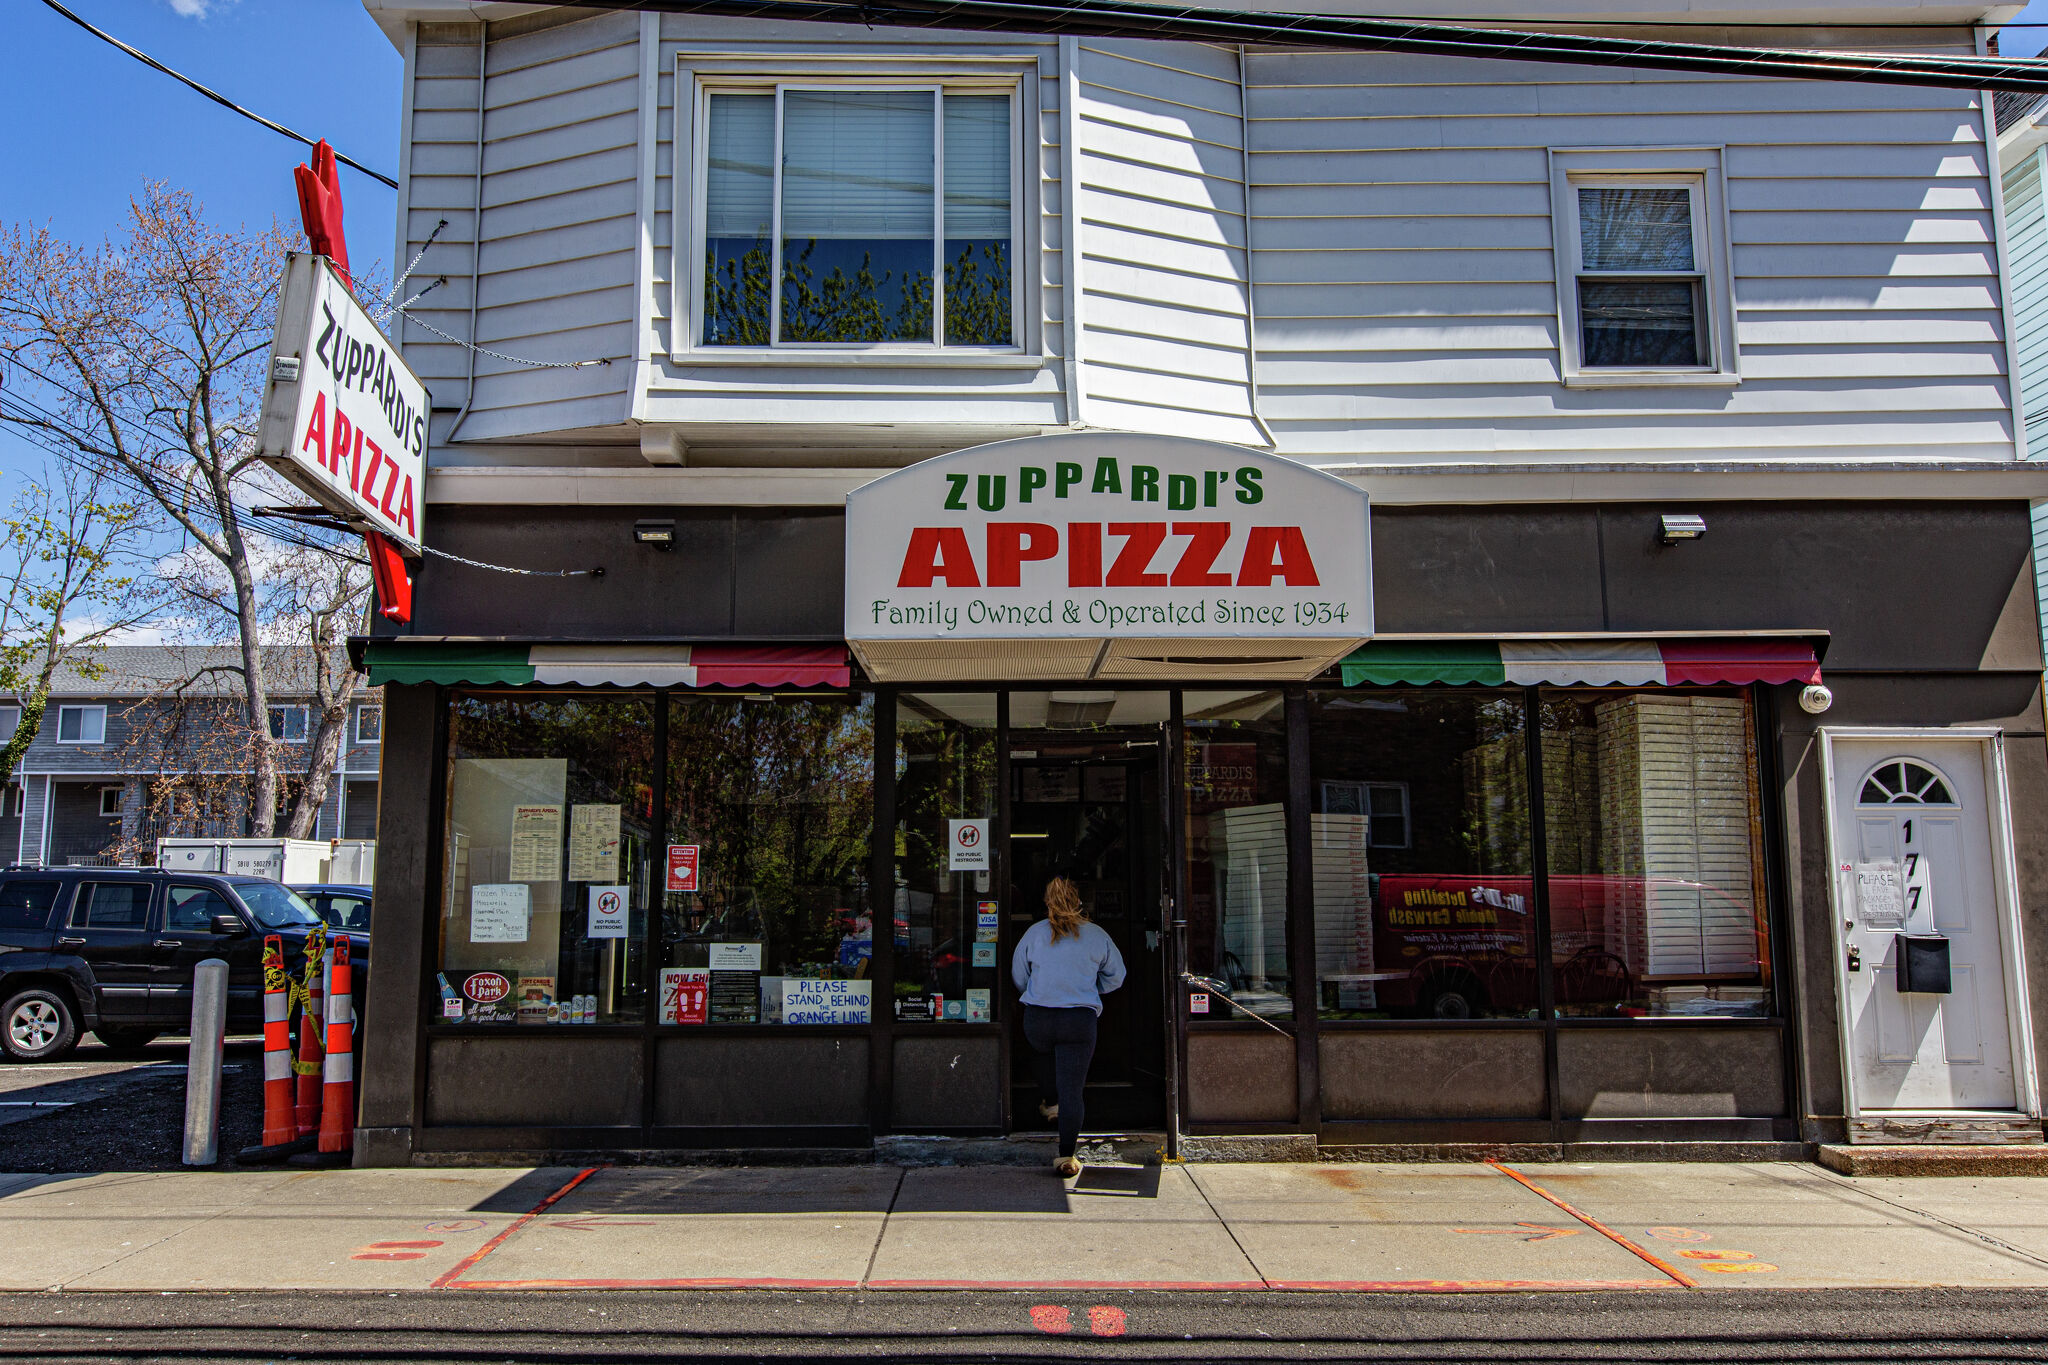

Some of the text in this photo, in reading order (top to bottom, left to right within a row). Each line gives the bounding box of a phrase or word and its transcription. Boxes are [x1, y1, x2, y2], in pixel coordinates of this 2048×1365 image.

[316, 300, 424, 457] ZUPPARDI'S
[302, 390, 416, 539] APIZZA
[944, 457, 1264, 512] ZUPPARDI'S
[896, 522, 1321, 588] APIZZA
[871, 600, 1350, 631] Family Owned & Operated Since 1934
[1903, 820, 1922, 911] 177
[470, 977, 502, 997] Foxon
[665, 974, 689, 984] NOW
[800, 981, 848, 993] PLEASE
[477, 986, 502, 999] Park
[787, 994, 870, 1007] STAND BEHIND
[788, 1011, 868, 1024] ORANGE LINE
